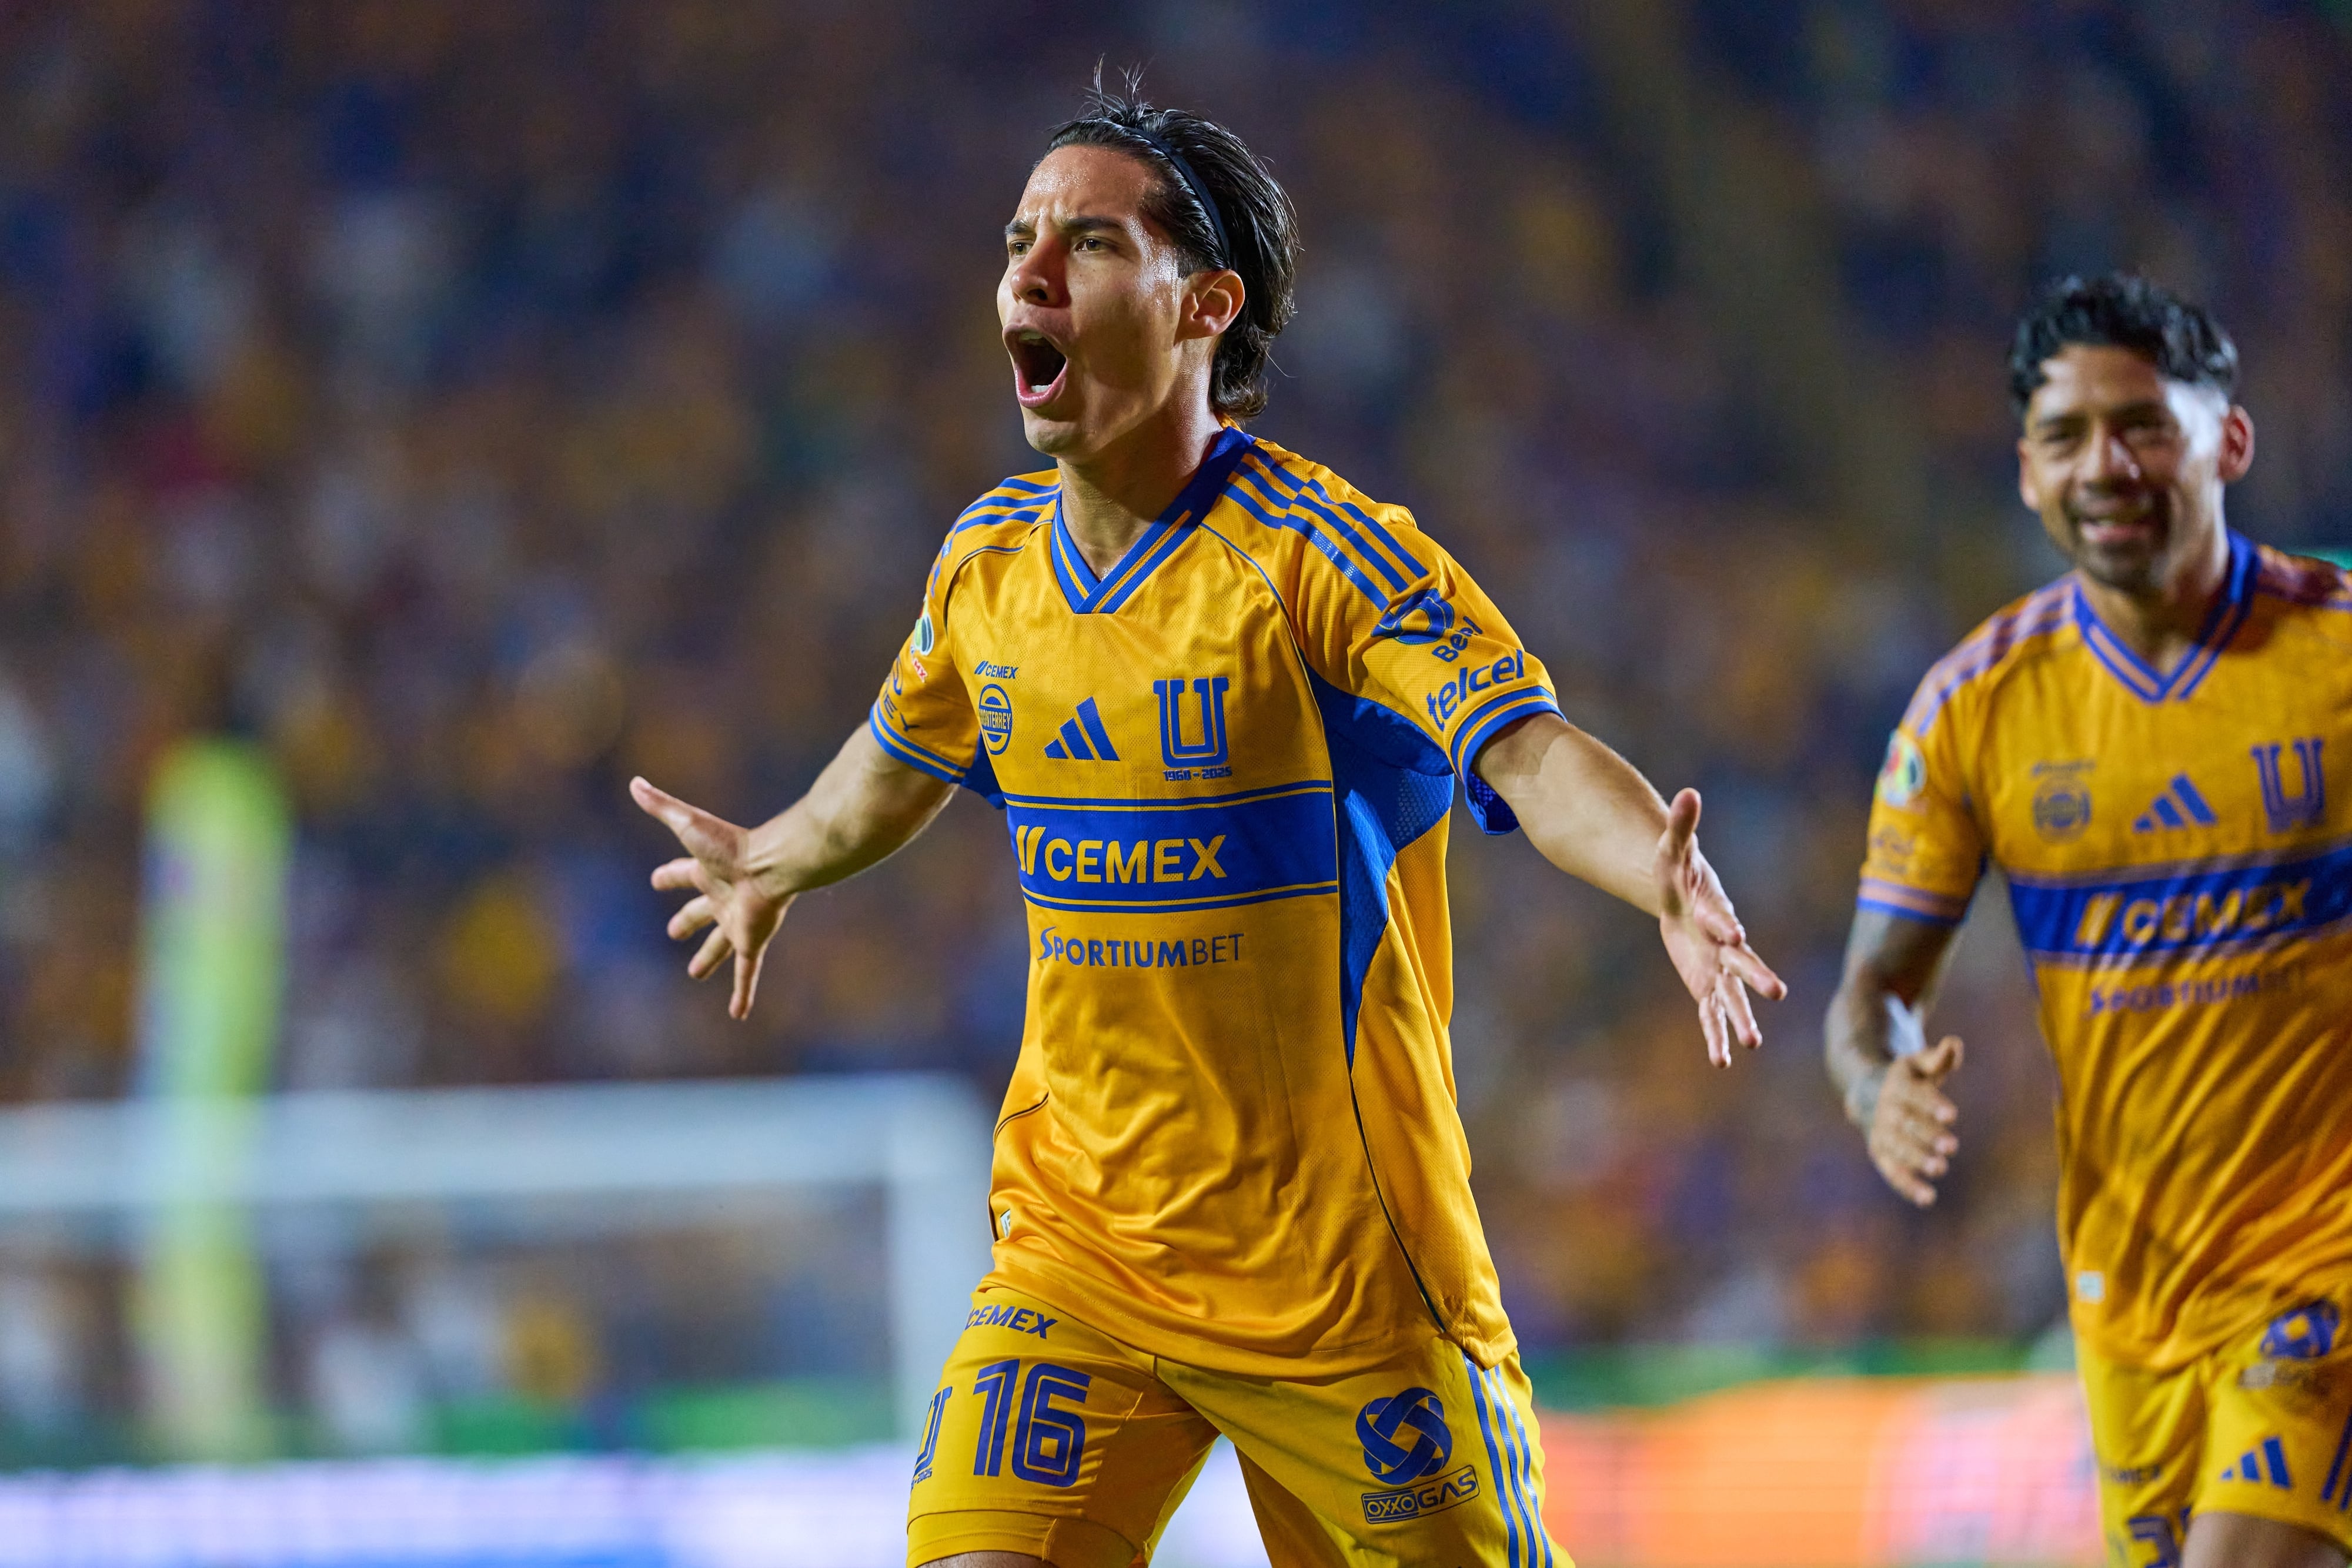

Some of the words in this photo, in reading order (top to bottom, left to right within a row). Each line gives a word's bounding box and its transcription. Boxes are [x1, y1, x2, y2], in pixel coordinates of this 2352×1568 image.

[985, 664, 1019, 679] CEMEX
[1426, 649, 1524, 732] telcel
[1045, 834, 1227, 884] CEMEX
[1038, 926, 1245, 968] SPORTIUMBET
[967, 1305, 1058, 1340] CEMEX
[973, 1358, 1091, 1488] 16
[1367, 1495, 1415, 1517] OXXO
[1418, 1470, 1476, 1509] GAS
